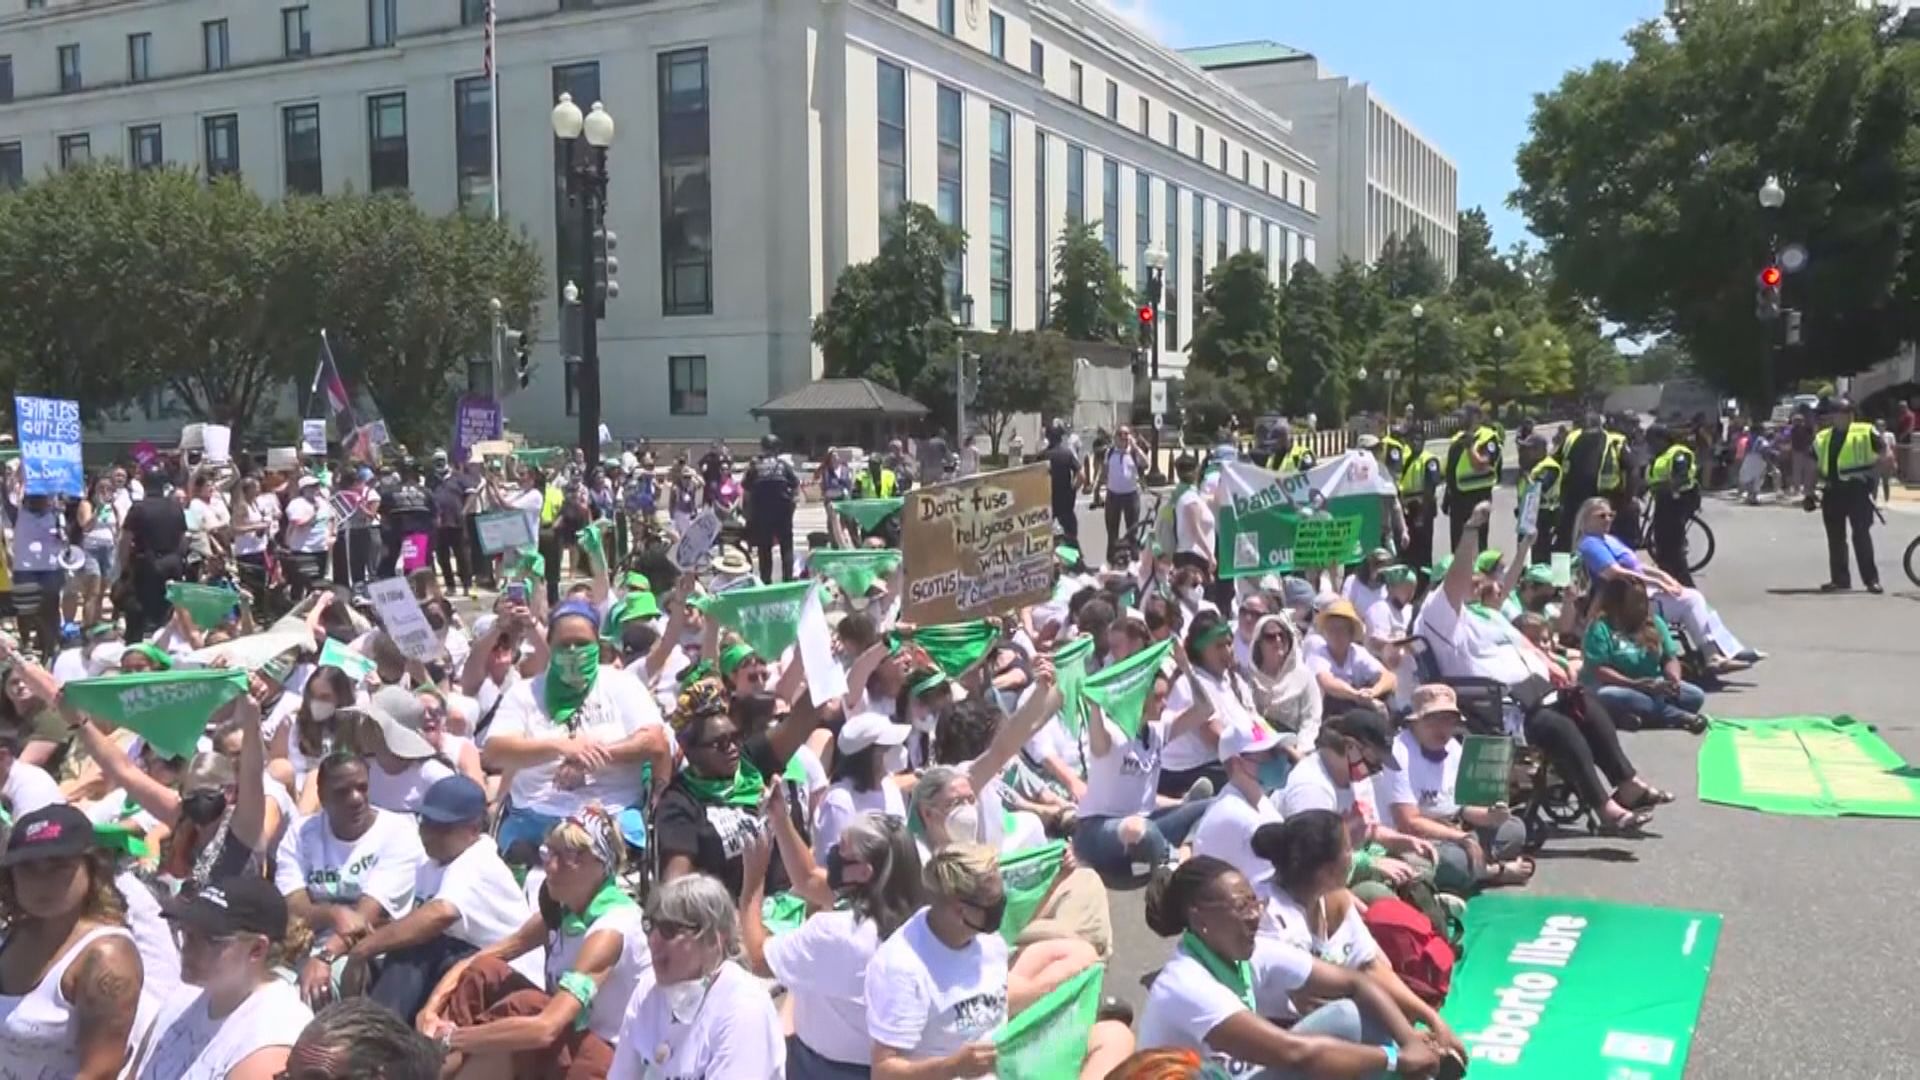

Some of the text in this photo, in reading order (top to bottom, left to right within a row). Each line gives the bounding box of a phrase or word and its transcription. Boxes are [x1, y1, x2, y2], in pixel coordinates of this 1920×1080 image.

[920, 487, 1008, 521] Don't fuse
[1233, 473, 1311, 513] bans off
[956, 517, 1014, 549] religious
[979, 543, 1011, 571] with
[911, 573, 957, 602] SCOTUS
[1460, 913, 1588, 1065] aborto libre
